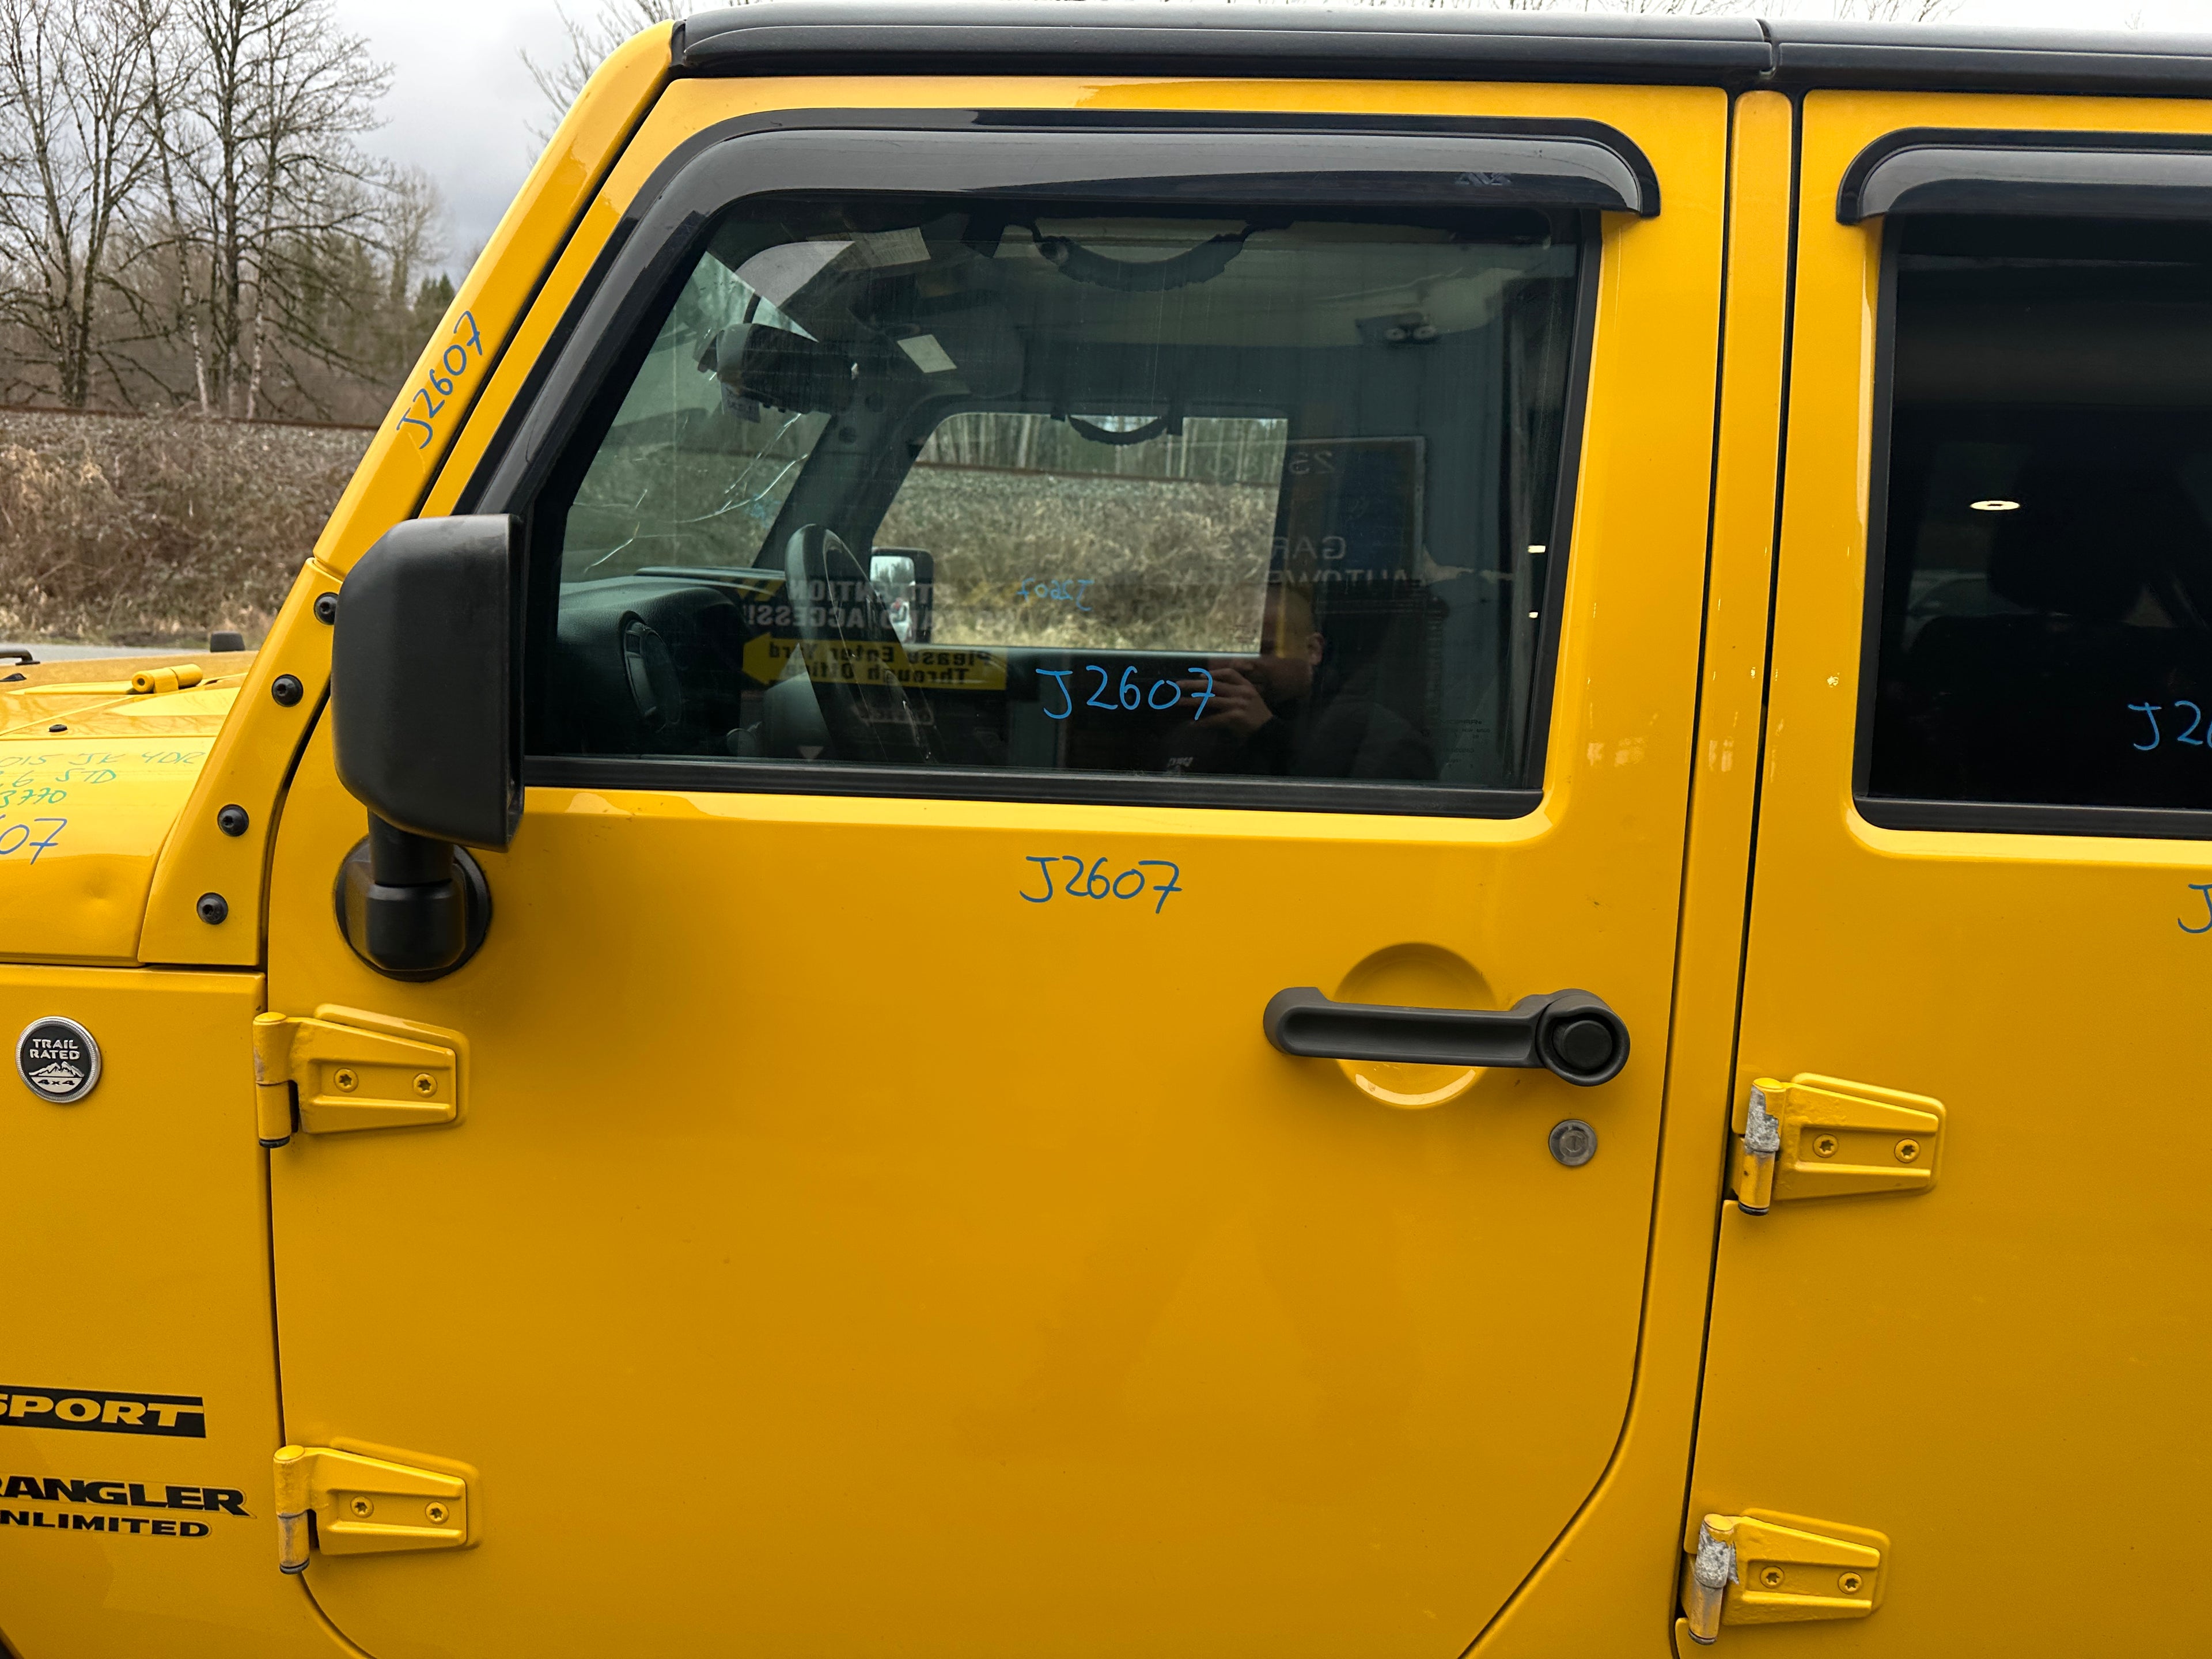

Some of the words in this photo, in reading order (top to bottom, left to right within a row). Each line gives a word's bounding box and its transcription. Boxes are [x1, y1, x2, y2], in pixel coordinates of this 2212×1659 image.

[396, 310, 483, 449] J2607
[1035, 665, 1215, 721] J2607
[141, 751, 206, 764] 4DR
[55, 768, 117, 784] STD
[1019, 855, 1183, 915] J2607
[29, 1049, 81, 1060] RATED
[32, 1039, 79, 1049] TRAIL
[0, 1475, 251, 1517] ANGLER
